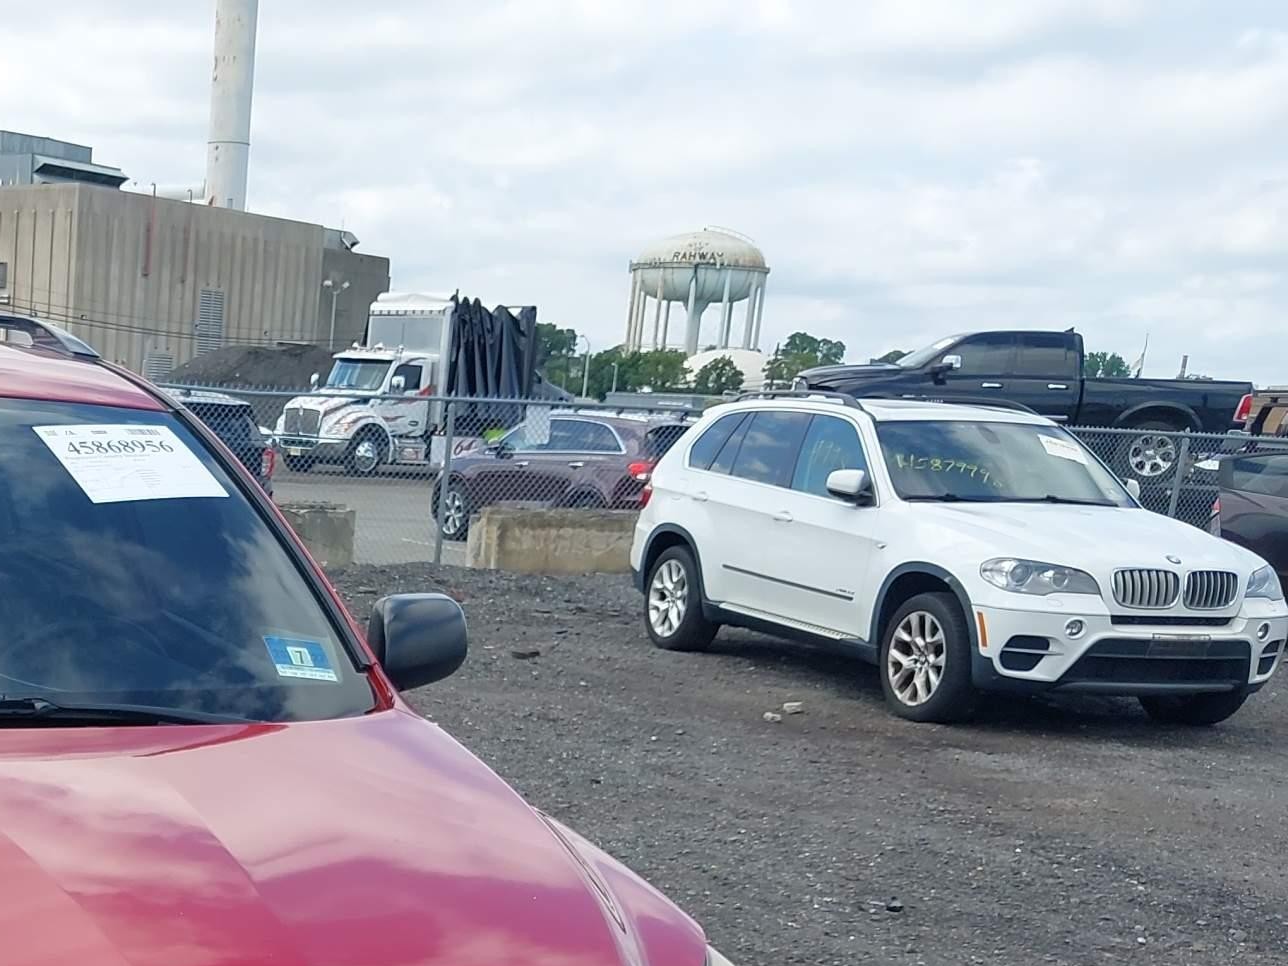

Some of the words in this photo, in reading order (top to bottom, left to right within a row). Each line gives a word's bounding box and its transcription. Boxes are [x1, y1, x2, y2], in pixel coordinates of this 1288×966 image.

[672, 251, 724, 262] RAHWAY
[68, 439, 174, 455] 45868956
[294, 650, 305, 665] 7
